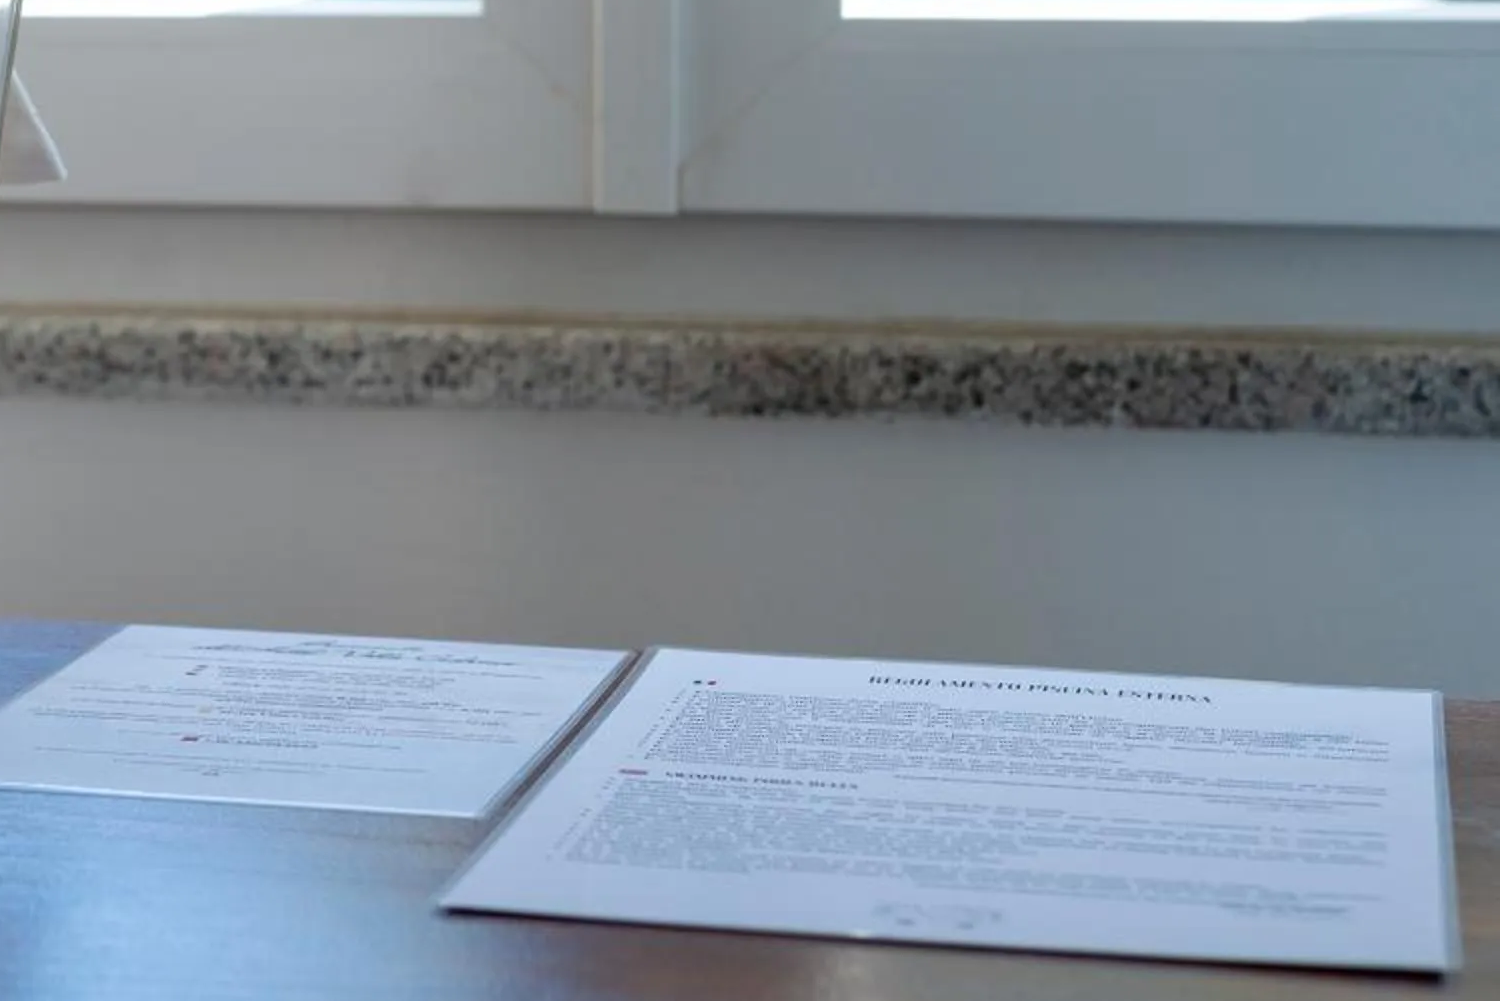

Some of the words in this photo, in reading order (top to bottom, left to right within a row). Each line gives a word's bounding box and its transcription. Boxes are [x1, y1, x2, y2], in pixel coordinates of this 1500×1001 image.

[868, 675, 1022, 690] REGOLAMENTO
[1028, 683, 1109, 696] PISCINA
[1117, 689, 1212, 703] ESTERNA
